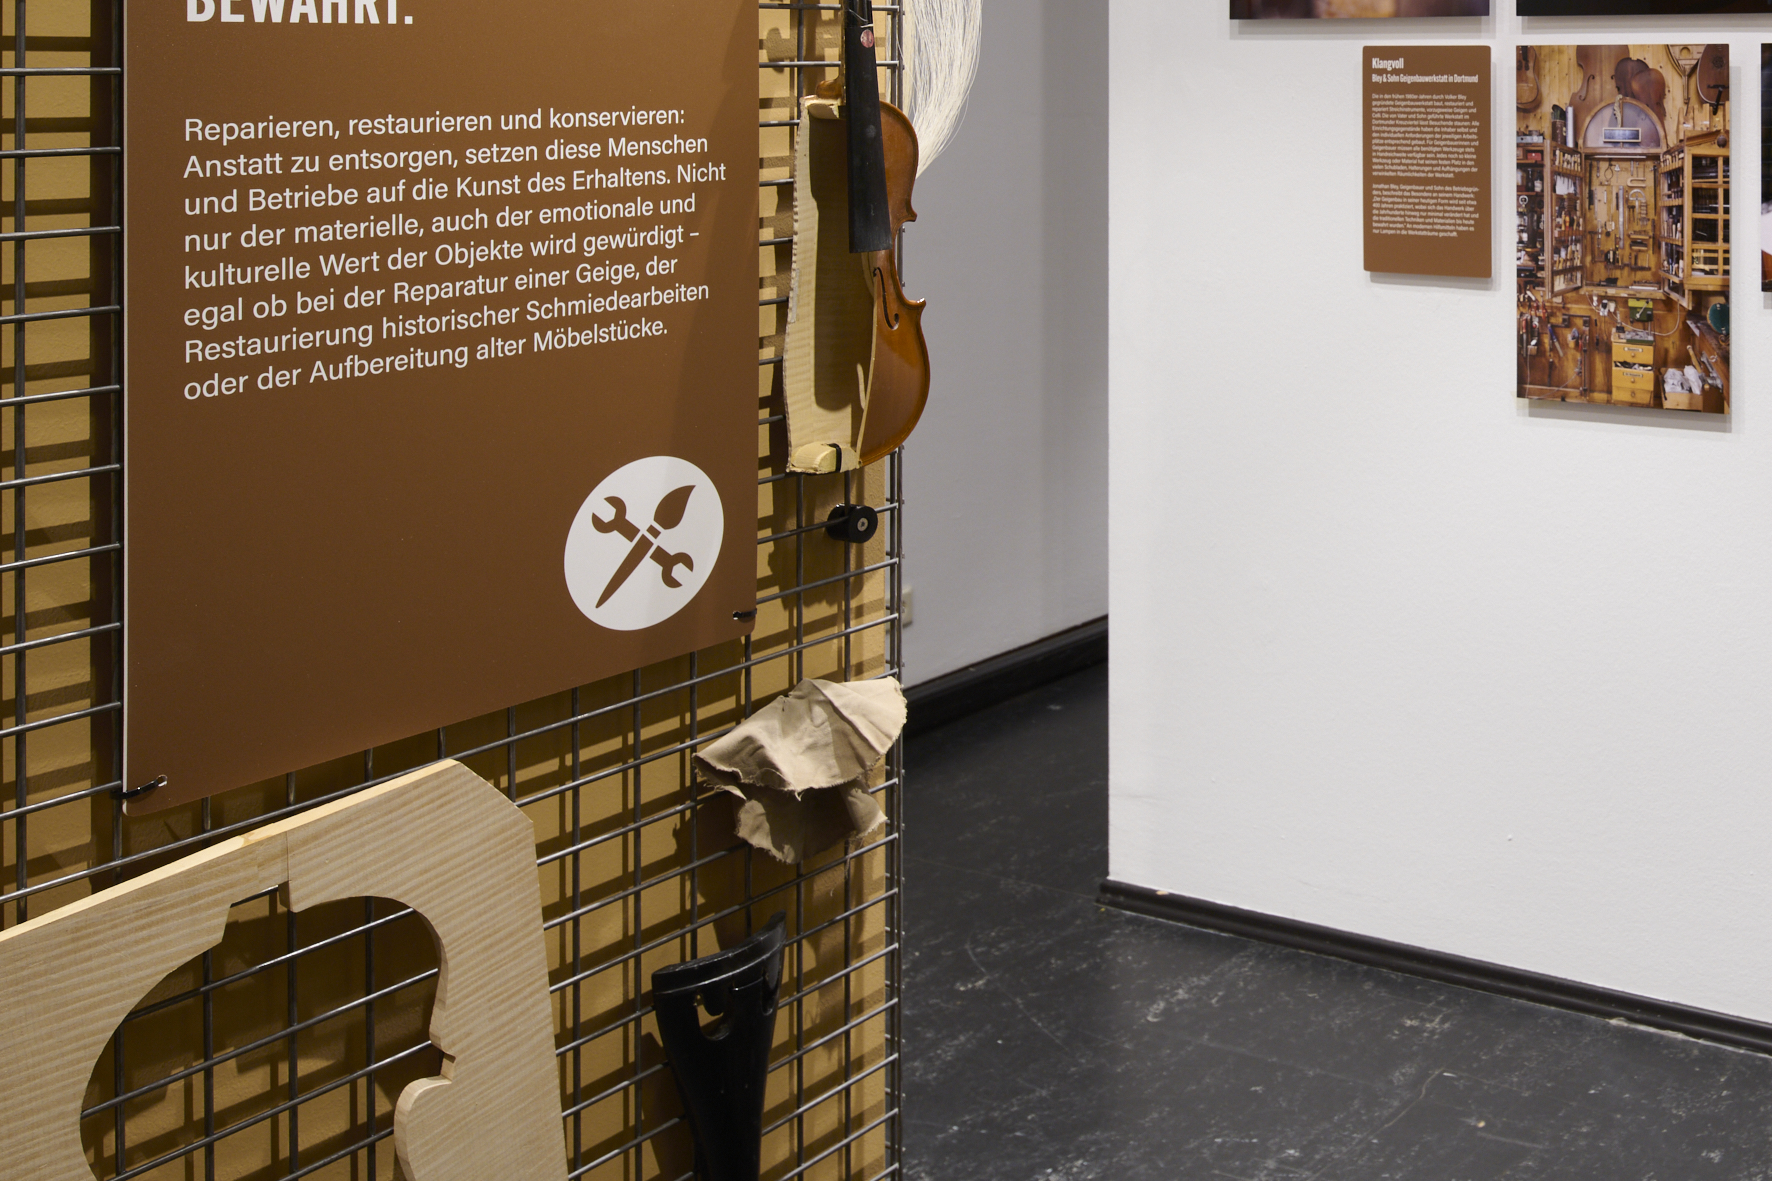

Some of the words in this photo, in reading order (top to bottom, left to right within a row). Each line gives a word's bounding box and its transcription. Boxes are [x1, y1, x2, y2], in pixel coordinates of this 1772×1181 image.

[1372, 57, 1404, 71] Klangvoll
[1372, 74, 1383, 84] Bley
[1382, 74, 1387, 83] &
[1387, 74, 1399, 83] Sohn
[1400, 74, 1448, 84] Geigenbauwerkstatt
[1453, 74, 1479, 83] Dortmund
[184, 114, 340, 147] Reparieren,
[348, 110, 492, 136] restaurieren
[500, 107, 542, 131] und
[549, 104, 685, 129] konservieren:
[182, 152, 284, 179] Anstatt
[290, 155, 320, 174] zu
[328, 148, 459, 173] entsorgen,
[464, 143, 538, 165] setzen
[544, 138, 602, 161] diese
[608, 133, 708, 158] Menschen
[184, 188, 238, 216] und
[248, 183, 359, 212] Betriebe
[366, 178, 407, 204] auf
[411, 177, 449, 201] die
[456, 174, 522, 198] Kunst
[527, 171, 566, 194] des
[572, 166, 671, 191] Erhaltens.
[676, 161, 727, 184] Nicht
[184, 231, 232, 253] nur
[240, 223, 286, 248] der
[294, 212, 425, 244] materielle,
[431, 207, 488, 233] auch
[495, 205, 533, 228] der
[538, 195, 654, 225] emotionale
[659, 192, 696, 215] und
[184, 256, 311, 290] kulturelle
[318, 251, 381, 277] Wert
[387, 246, 428, 271] der
[434, 238, 524, 269] Objekte
[529, 231, 576, 257] wird
[582, 224, 685, 258] gewürdigt
[183, 296, 243, 331] egal
[252, 293, 288, 319] ob
[296, 287, 335, 315] bei
[343, 285, 386, 309] der
[393, 274, 509, 306] Reparatur
[514, 267, 570, 291] einer
[575, 259, 640, 286] Geige,
[645, 255, 679, 277] der
[185, 324, 373, 364] Restaurierung
[382, 304, 520, 340] historischer
[525, 282, 709, 322] Schmiedearbeiten
[183, 372, 249, 401] oder
[256, 365, 302, 391] der
[308, 346, 469, 384] Aufbereitung
[475, 336, 527, 361] alter
[533, 316, 668, 353] Möbelstücke.
